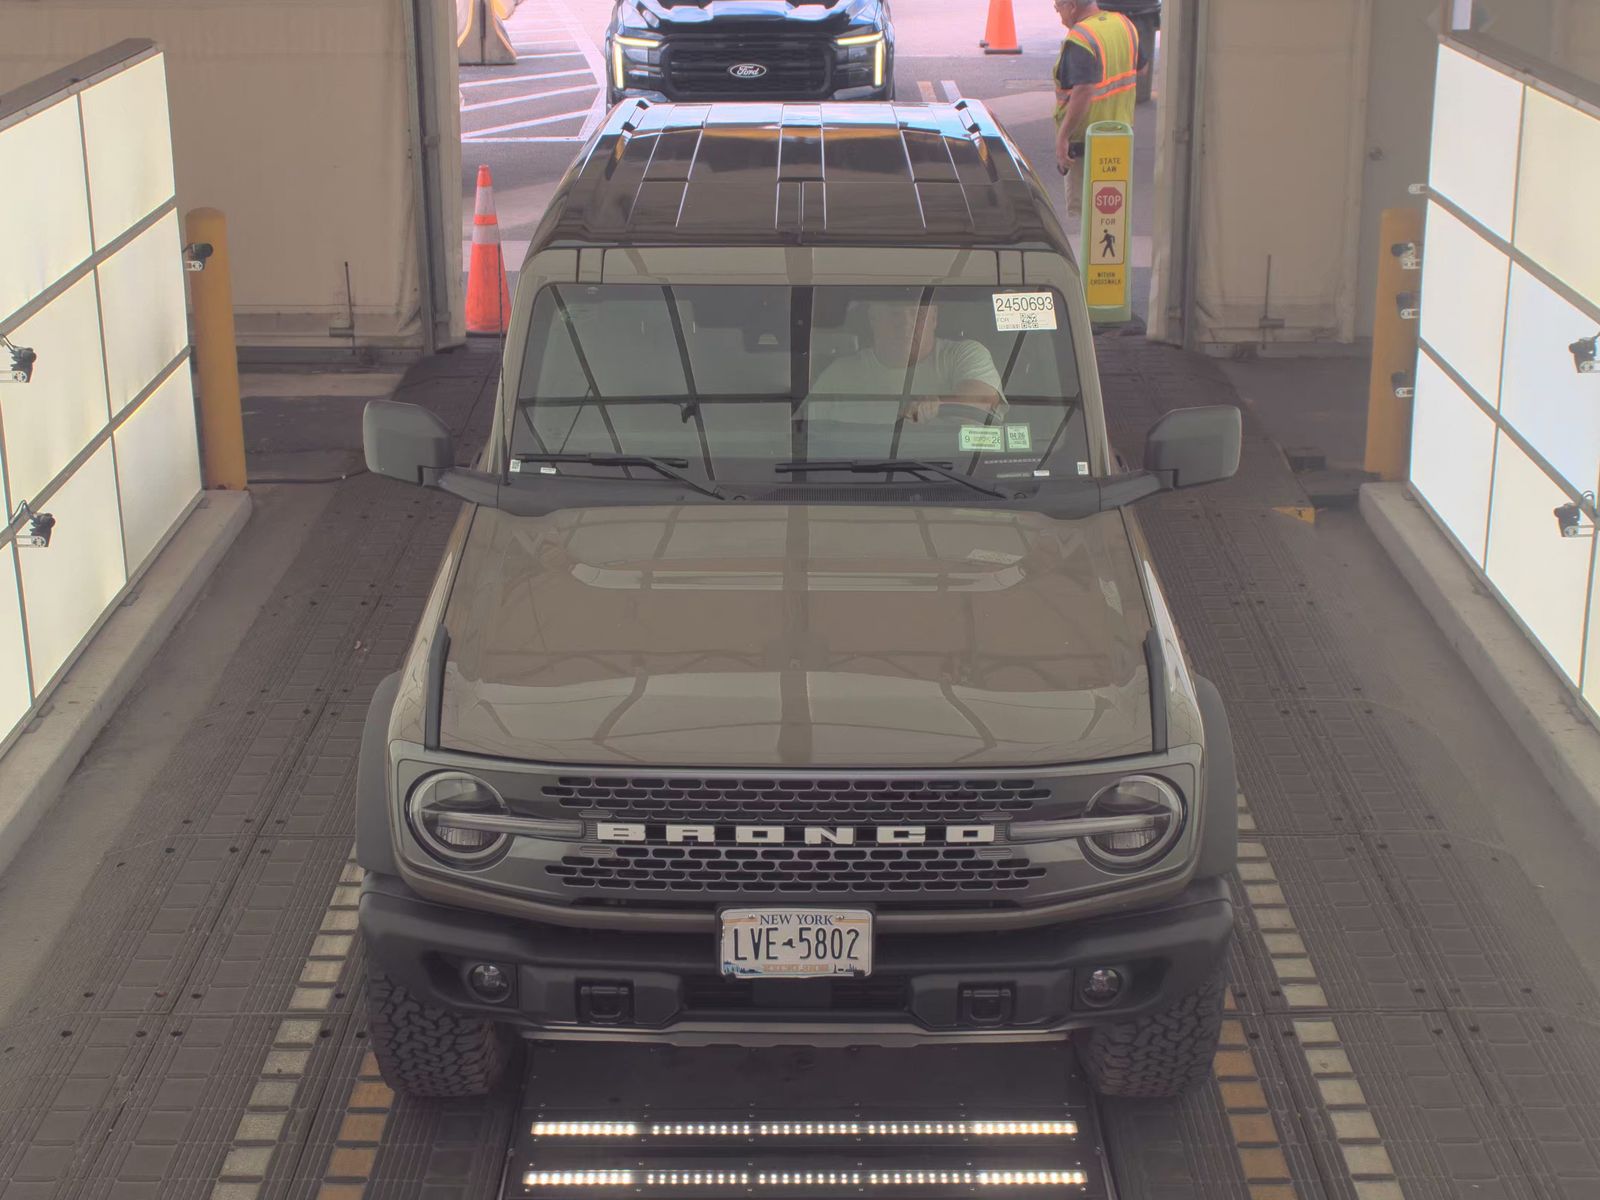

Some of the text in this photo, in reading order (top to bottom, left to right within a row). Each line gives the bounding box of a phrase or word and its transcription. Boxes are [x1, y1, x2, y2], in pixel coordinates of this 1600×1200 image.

[737, 65, 760, 76] Ford
[1096, 195, 1122, 207] STOP
[995, 296, 1054, 312] 2450693
[596, 822, 996, 845] BRONCO
[759, 914, 834, 926] NEW YORK
[733, 927, 860, 961] LVE 5802
